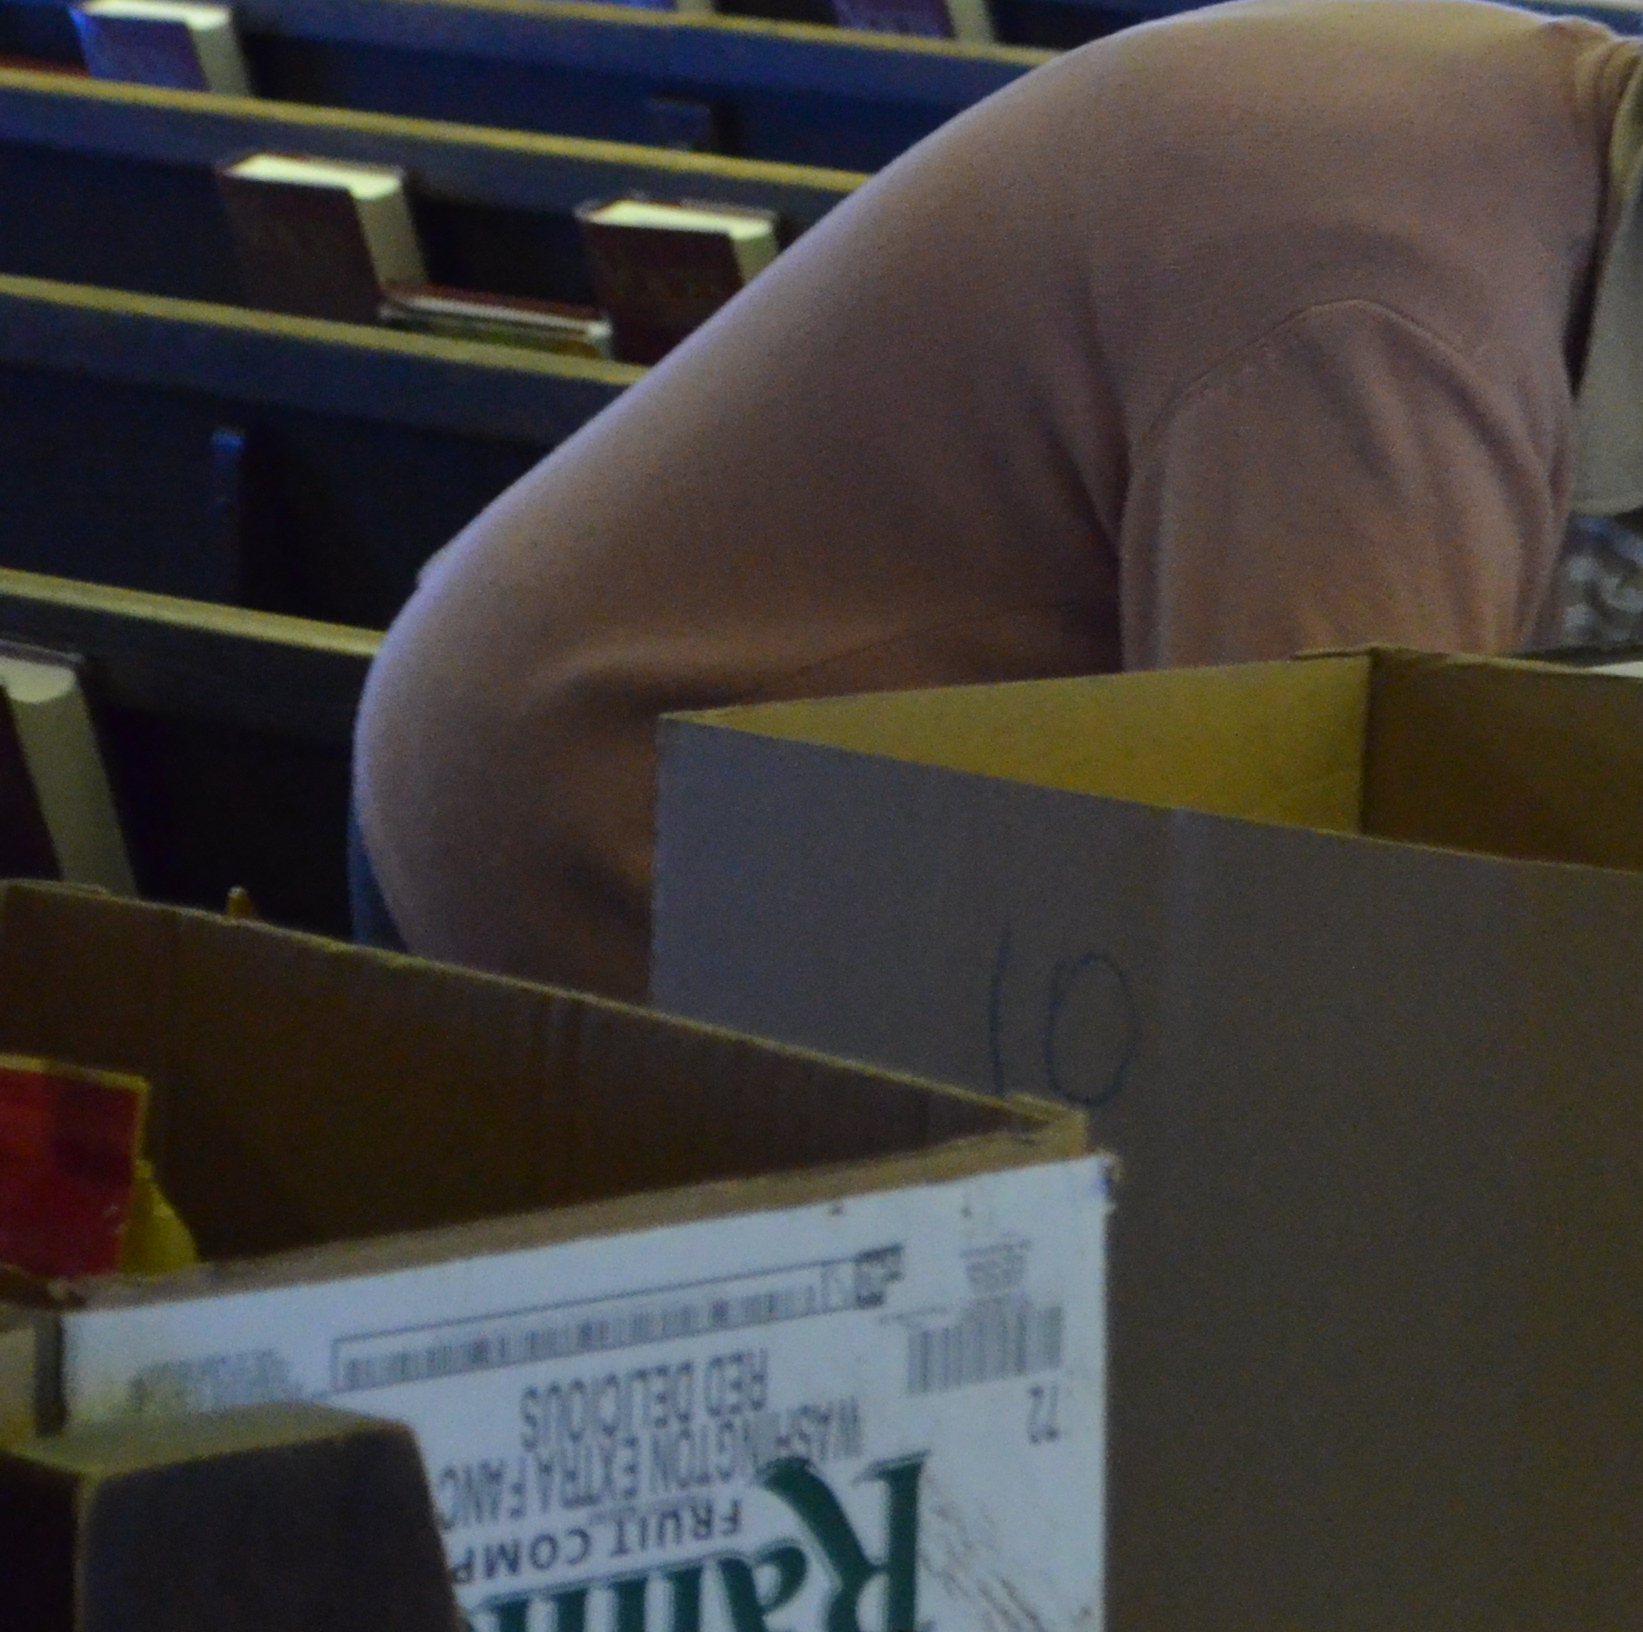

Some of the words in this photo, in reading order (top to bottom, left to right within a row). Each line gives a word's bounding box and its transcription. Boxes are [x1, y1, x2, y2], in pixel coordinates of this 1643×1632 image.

[519, 1364, 696, 1453] DELICIOUS
[706, 1347, 769, 1417] RED
[1026, 1384, 1061, 1446] 72
[538, 1435, 640, 1515] EXTRA
[610, 1496, 744, 1559] FRUIT
